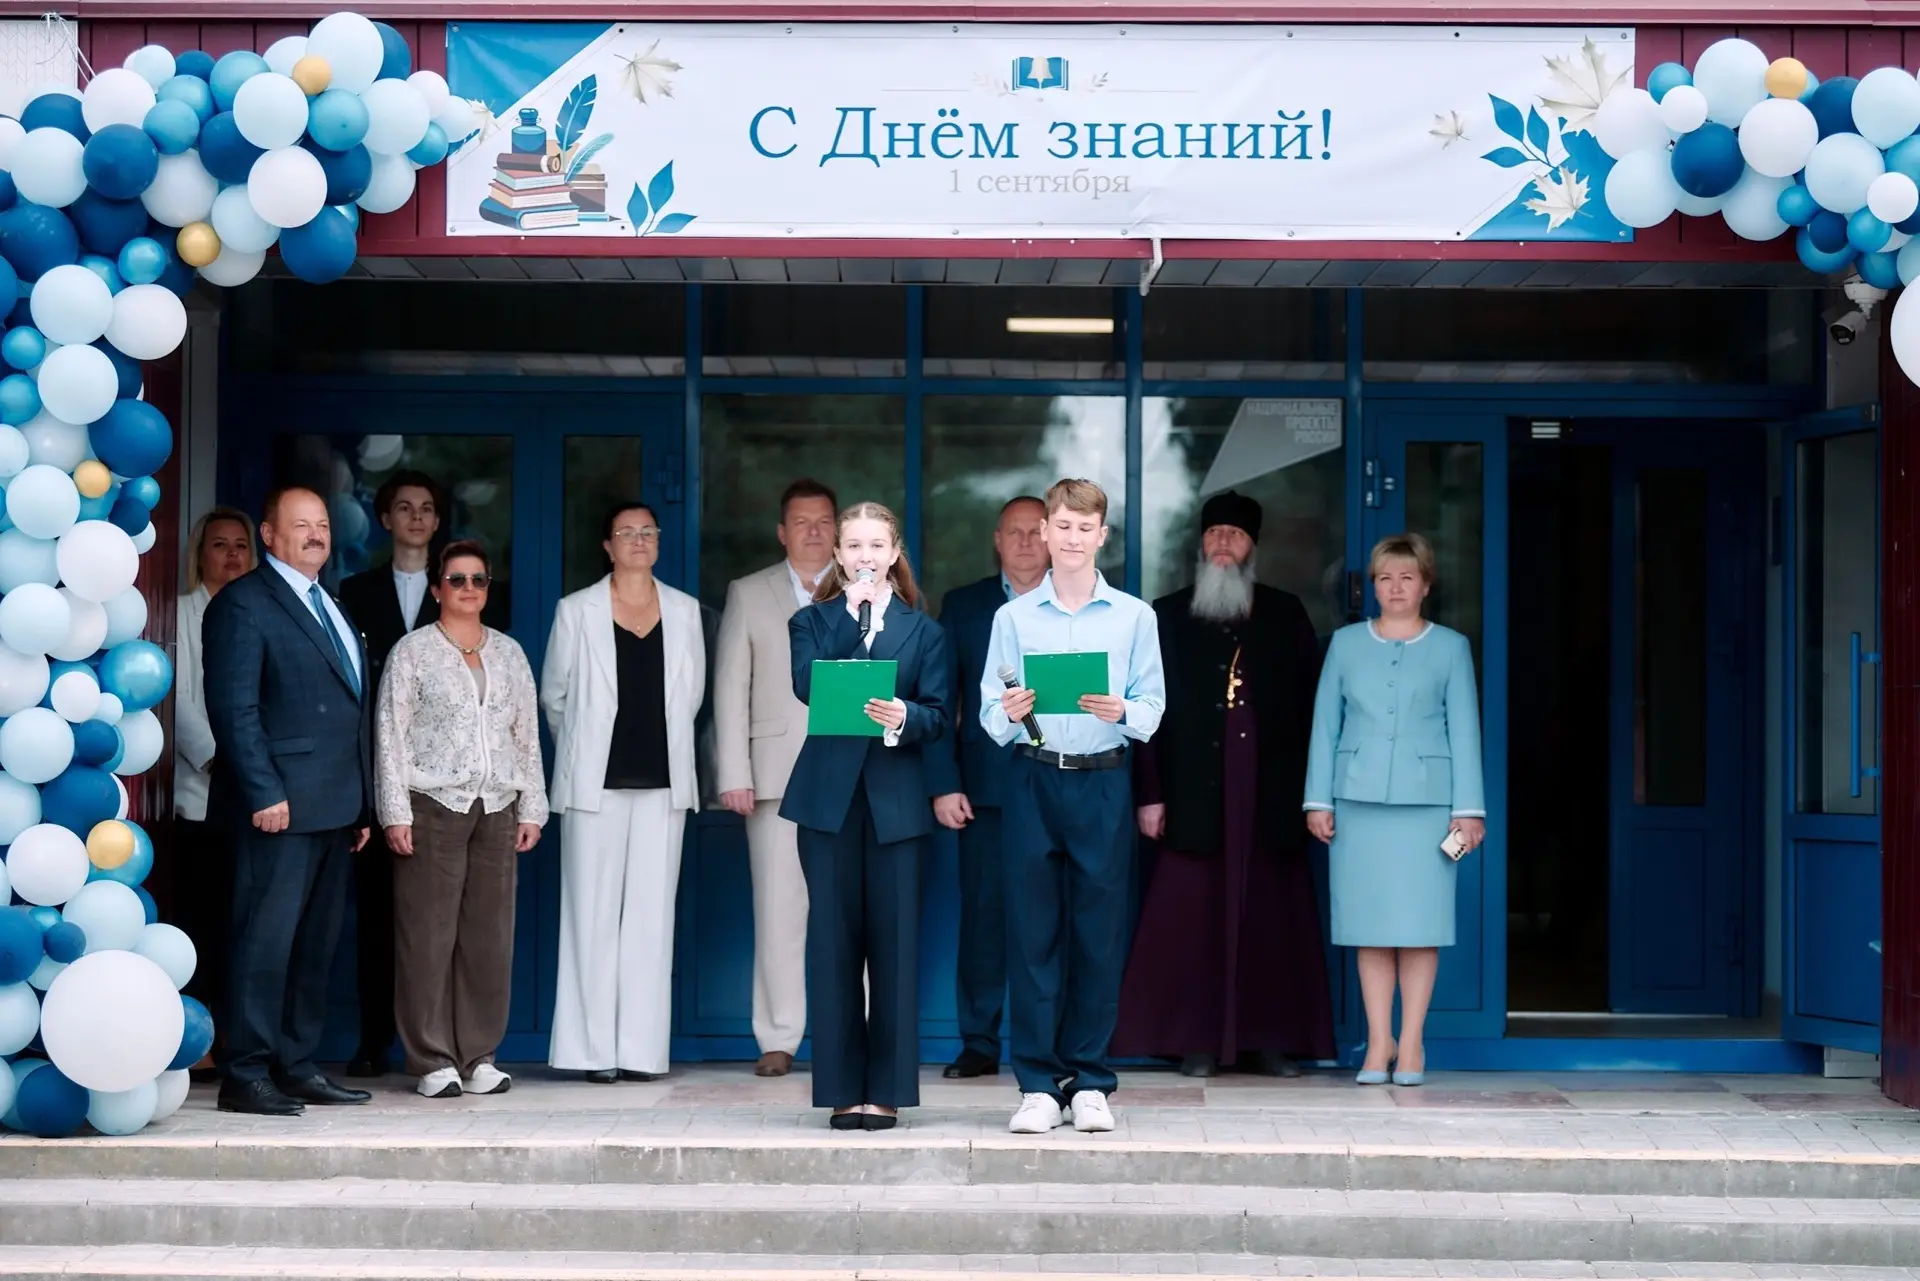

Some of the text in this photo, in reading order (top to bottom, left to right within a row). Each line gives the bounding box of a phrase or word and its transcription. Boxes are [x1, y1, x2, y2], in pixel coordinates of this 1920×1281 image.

[748, 105, 1333, 168] С Днём знаний!
[949, 167, 1132, 201] 1 сентября
